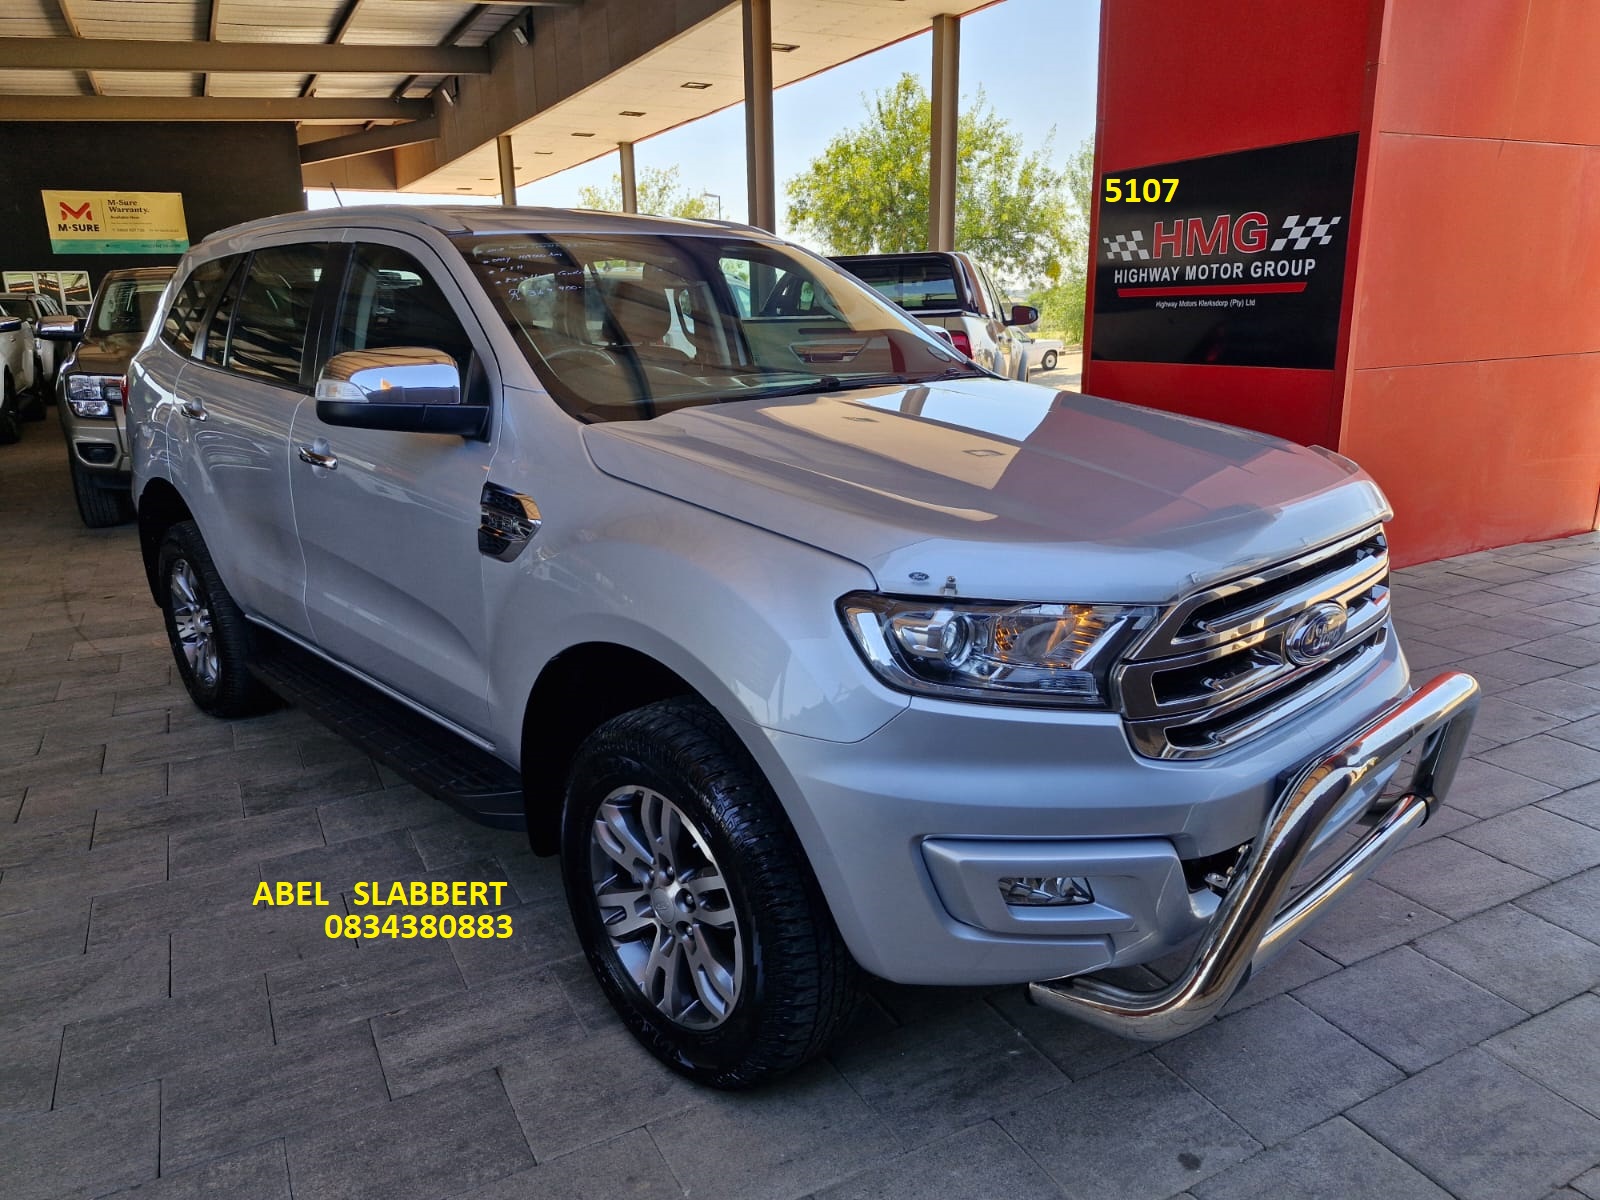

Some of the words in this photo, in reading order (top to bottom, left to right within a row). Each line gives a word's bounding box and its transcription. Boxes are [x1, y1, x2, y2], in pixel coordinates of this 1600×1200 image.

[108, 206, 150, 214] Warranty.
[1152, 211, 1268, 259] HMG
[1114, 266, 1181, 284] HIGHWAY
[1185, 263, 1243, 281] MOTOR
[1250, 259, 1316, 278] GROUP
[1155, 300, 1178, 309] Highway
[1198, 299, 1229, 308] Klerksdorp
[1229, 298, 1244, 308] (Pty)
[1245, 298, 1256, 307] Ltd
